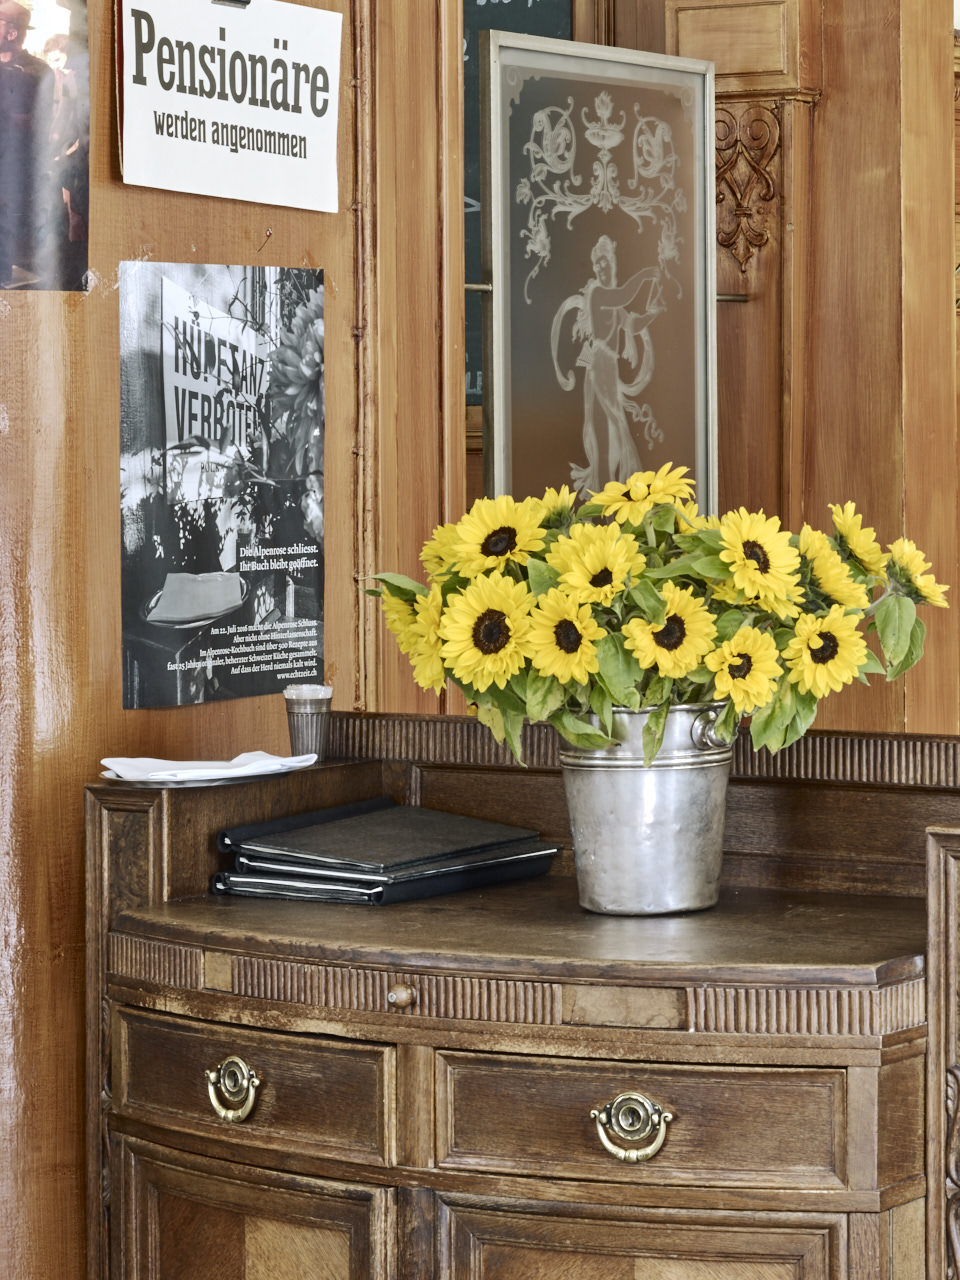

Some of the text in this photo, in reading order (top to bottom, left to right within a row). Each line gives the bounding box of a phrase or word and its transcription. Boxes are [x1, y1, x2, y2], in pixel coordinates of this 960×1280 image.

[130, 8, 330, 118] Pensionäre
[153, 109, 307, 160] werden angenommen
[240, 542, 319, 559] Die Alpenrose schliesst.
[240, 556, 319, 572] Ihr Buch bleibt geöffnet.
[210, 626, 219, 635] Am
[227, 624, 237, 635] Juli
[233, 634, 245, 643] Aber
[260, 662, 273, 671] Herd
[273, 660, 293, 670] niemals
